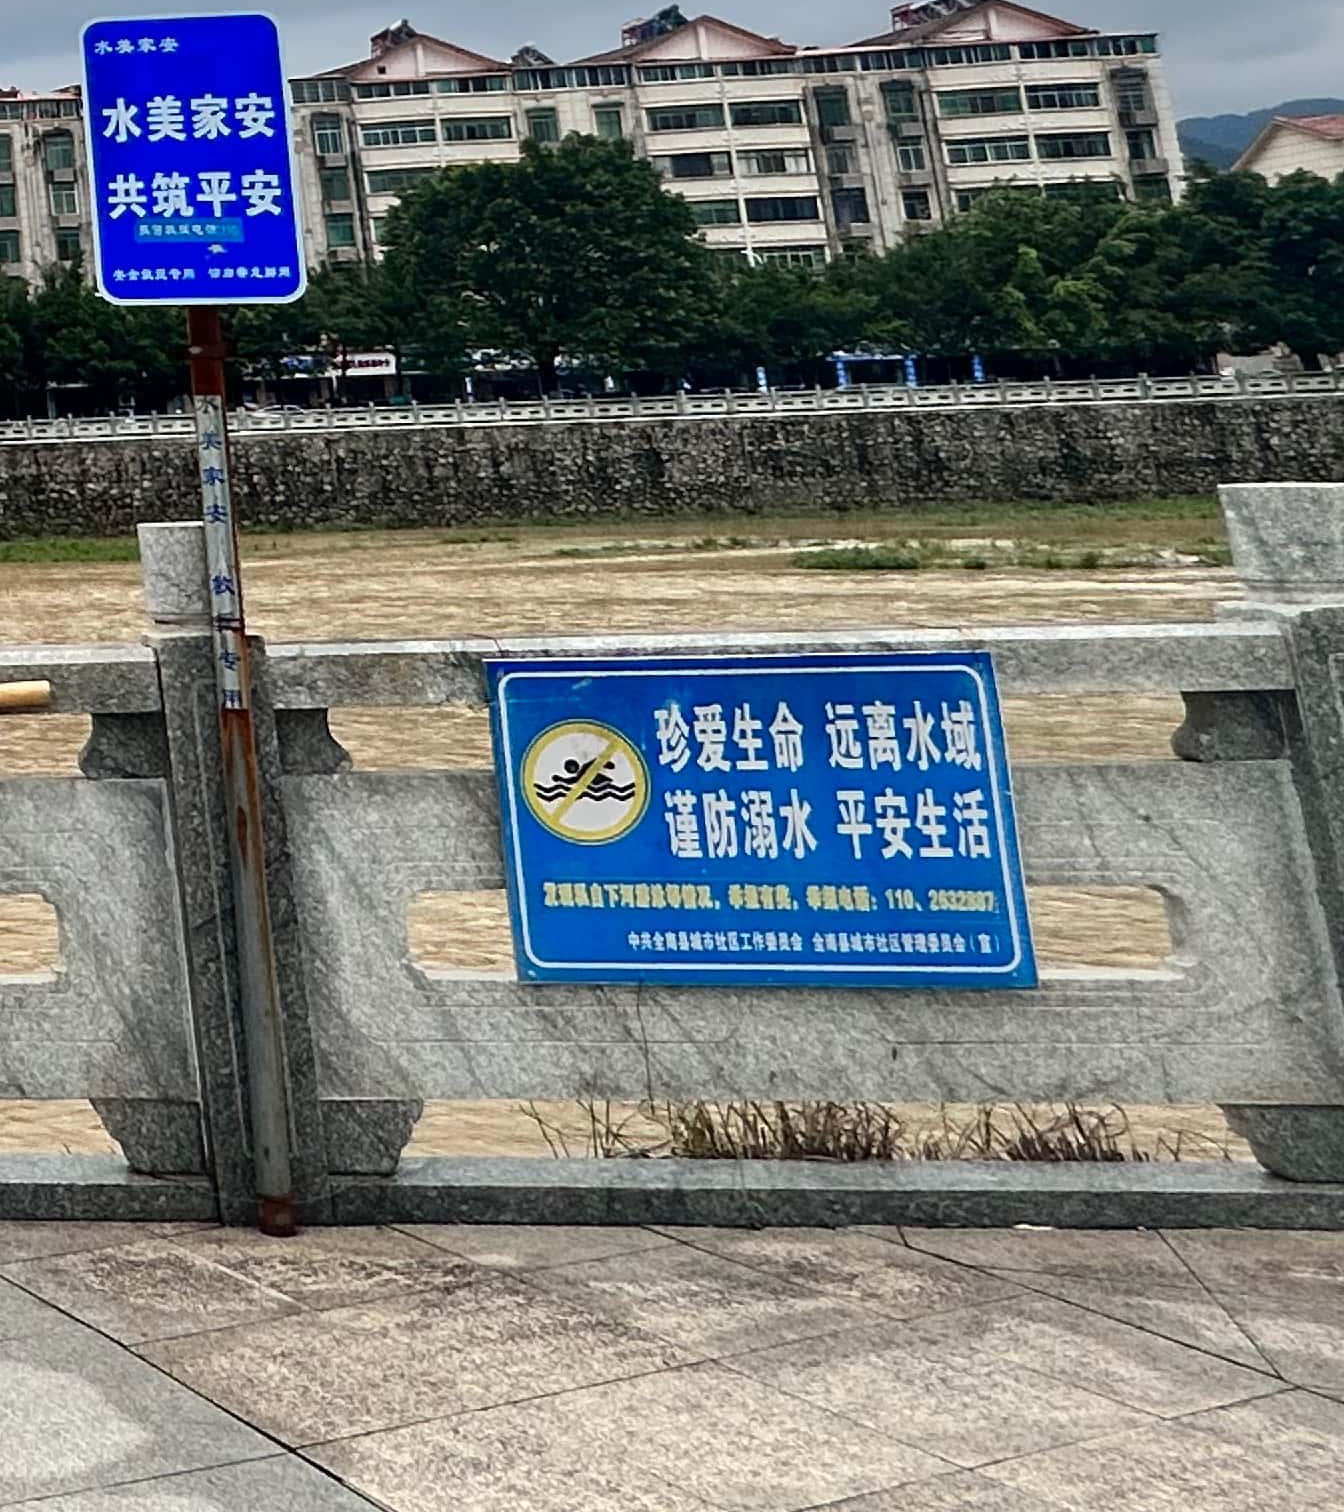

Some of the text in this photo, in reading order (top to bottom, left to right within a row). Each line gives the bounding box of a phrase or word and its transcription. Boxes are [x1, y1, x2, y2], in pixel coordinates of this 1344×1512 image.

[94, 37, 179, 55] 水美家安
[102, 92, 275, 143] 水美家安
[107, 169, 282, 220] 共筑平安
[653, 699, 983, 774] 珍爱生命 远离水域
[664, 787, 993, 860] 谨防溺水 平安生活
